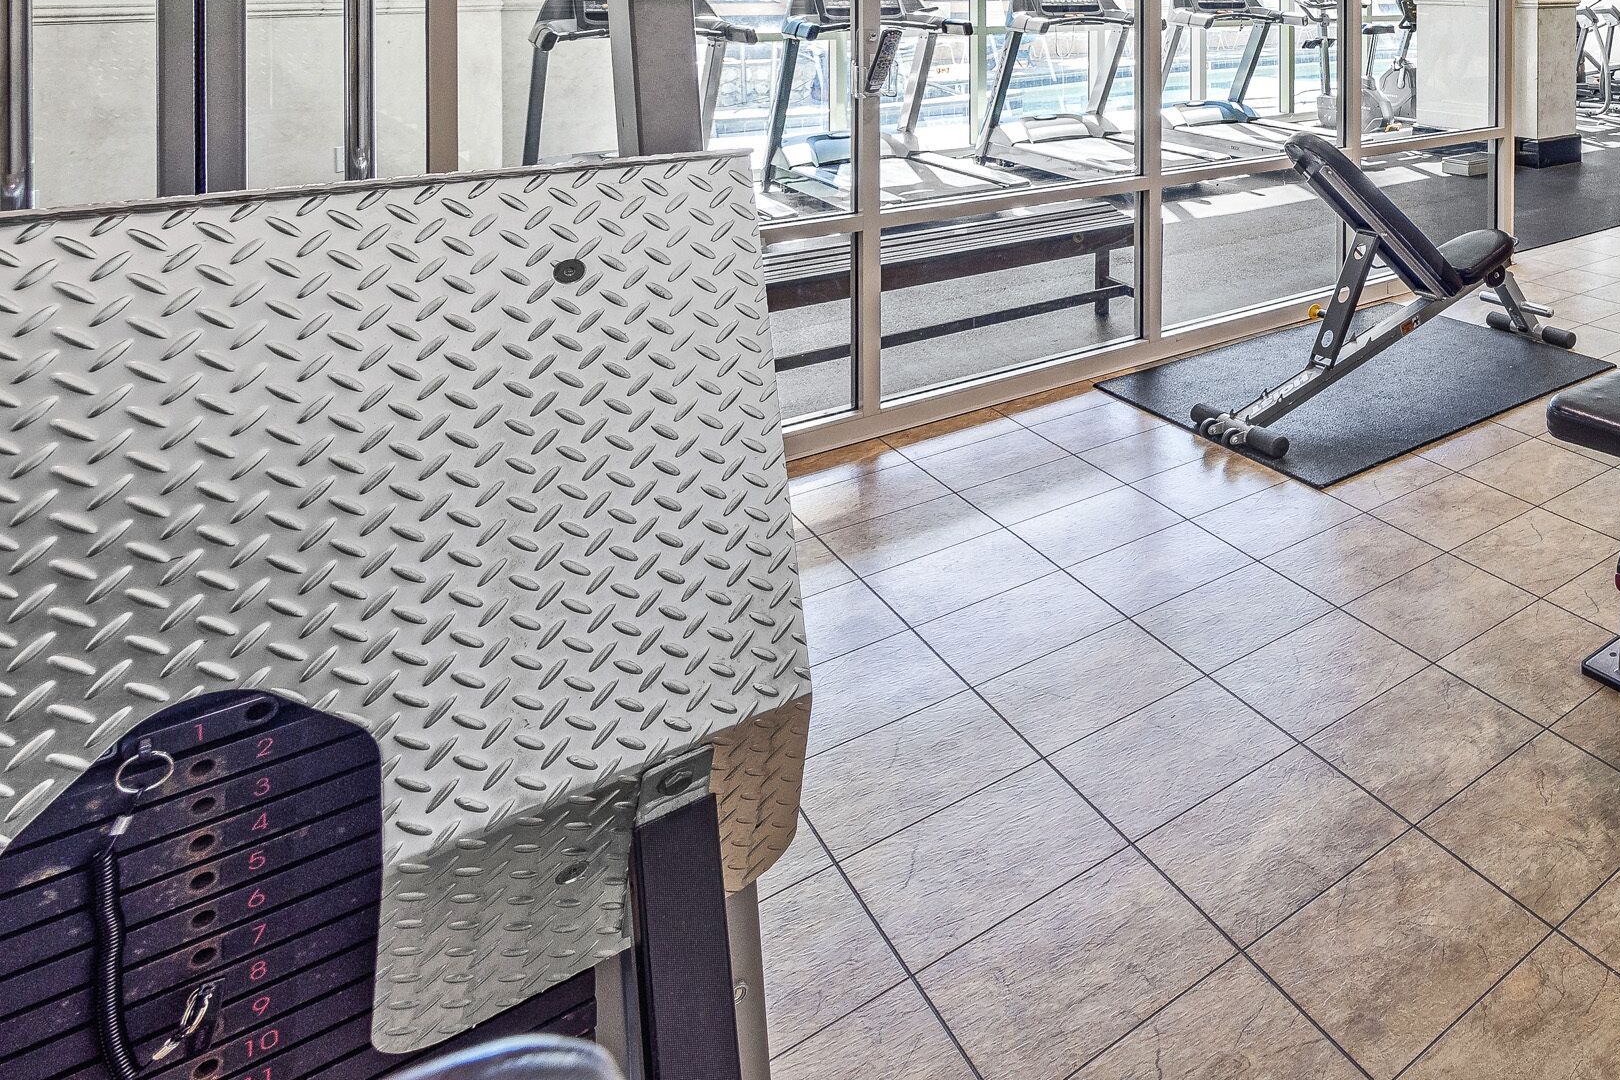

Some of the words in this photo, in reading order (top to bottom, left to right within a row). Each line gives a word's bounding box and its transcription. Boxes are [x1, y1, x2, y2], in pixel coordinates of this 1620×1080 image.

[194, 724, 204, 742] 1
[256, 738, 274, 758] 2
[254, 777, 270, 797] 3
[252, 812, 268, 831] 4
[249, 850, 266, 870] 5
[248, 889, 266, 908] 6
[253, 923, 266, 945] 7
[250, 960, 268, 981] 8
[252, 996, 270, 1016] 9
[244, 1029, 279, 1058] 10
[244, 1067, 272, 1080] 1
